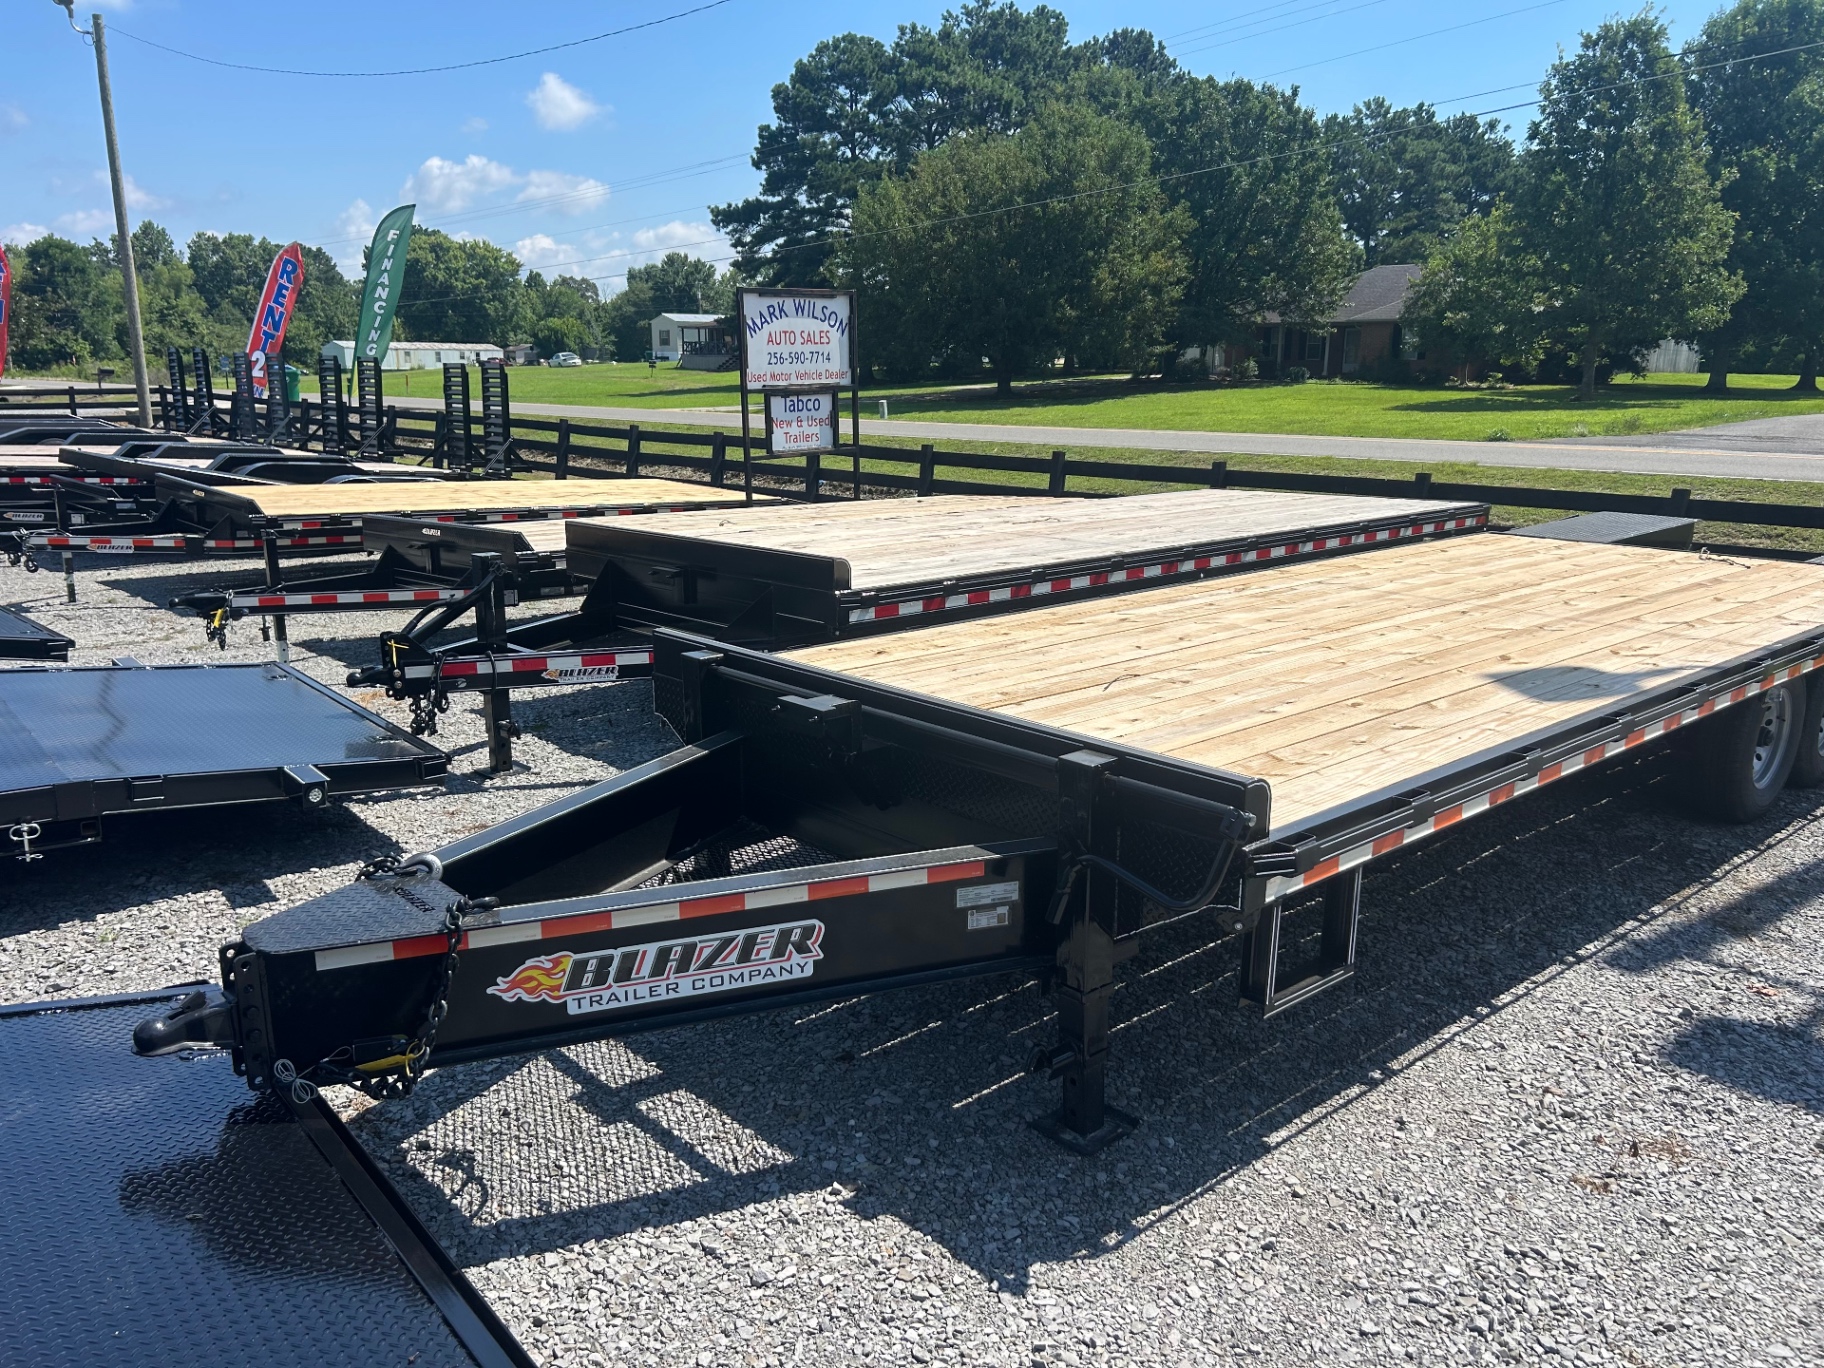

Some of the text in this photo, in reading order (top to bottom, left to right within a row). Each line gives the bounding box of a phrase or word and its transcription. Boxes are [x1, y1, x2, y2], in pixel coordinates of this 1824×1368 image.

[366, 229, 400, 356] FINANCING
[260, 255, 299, 353] RENT
[745, 298, 849, 339] MARK WILSON
[766, 330, 832, 346] AUTO SALES
[766, 351, 832, 366] 256-590-7714
[747, 368, 849, 383] Used Motor Vehicle Dealer
[781, 394, 821, 413] Tabco
[772, 413, 830, 430] New & Used
[783, 431, 820, 444] Trailers
[562, 923, 823, 993] BLAZER
[572, 961, 809, 1010] TRAILER COMPANY
